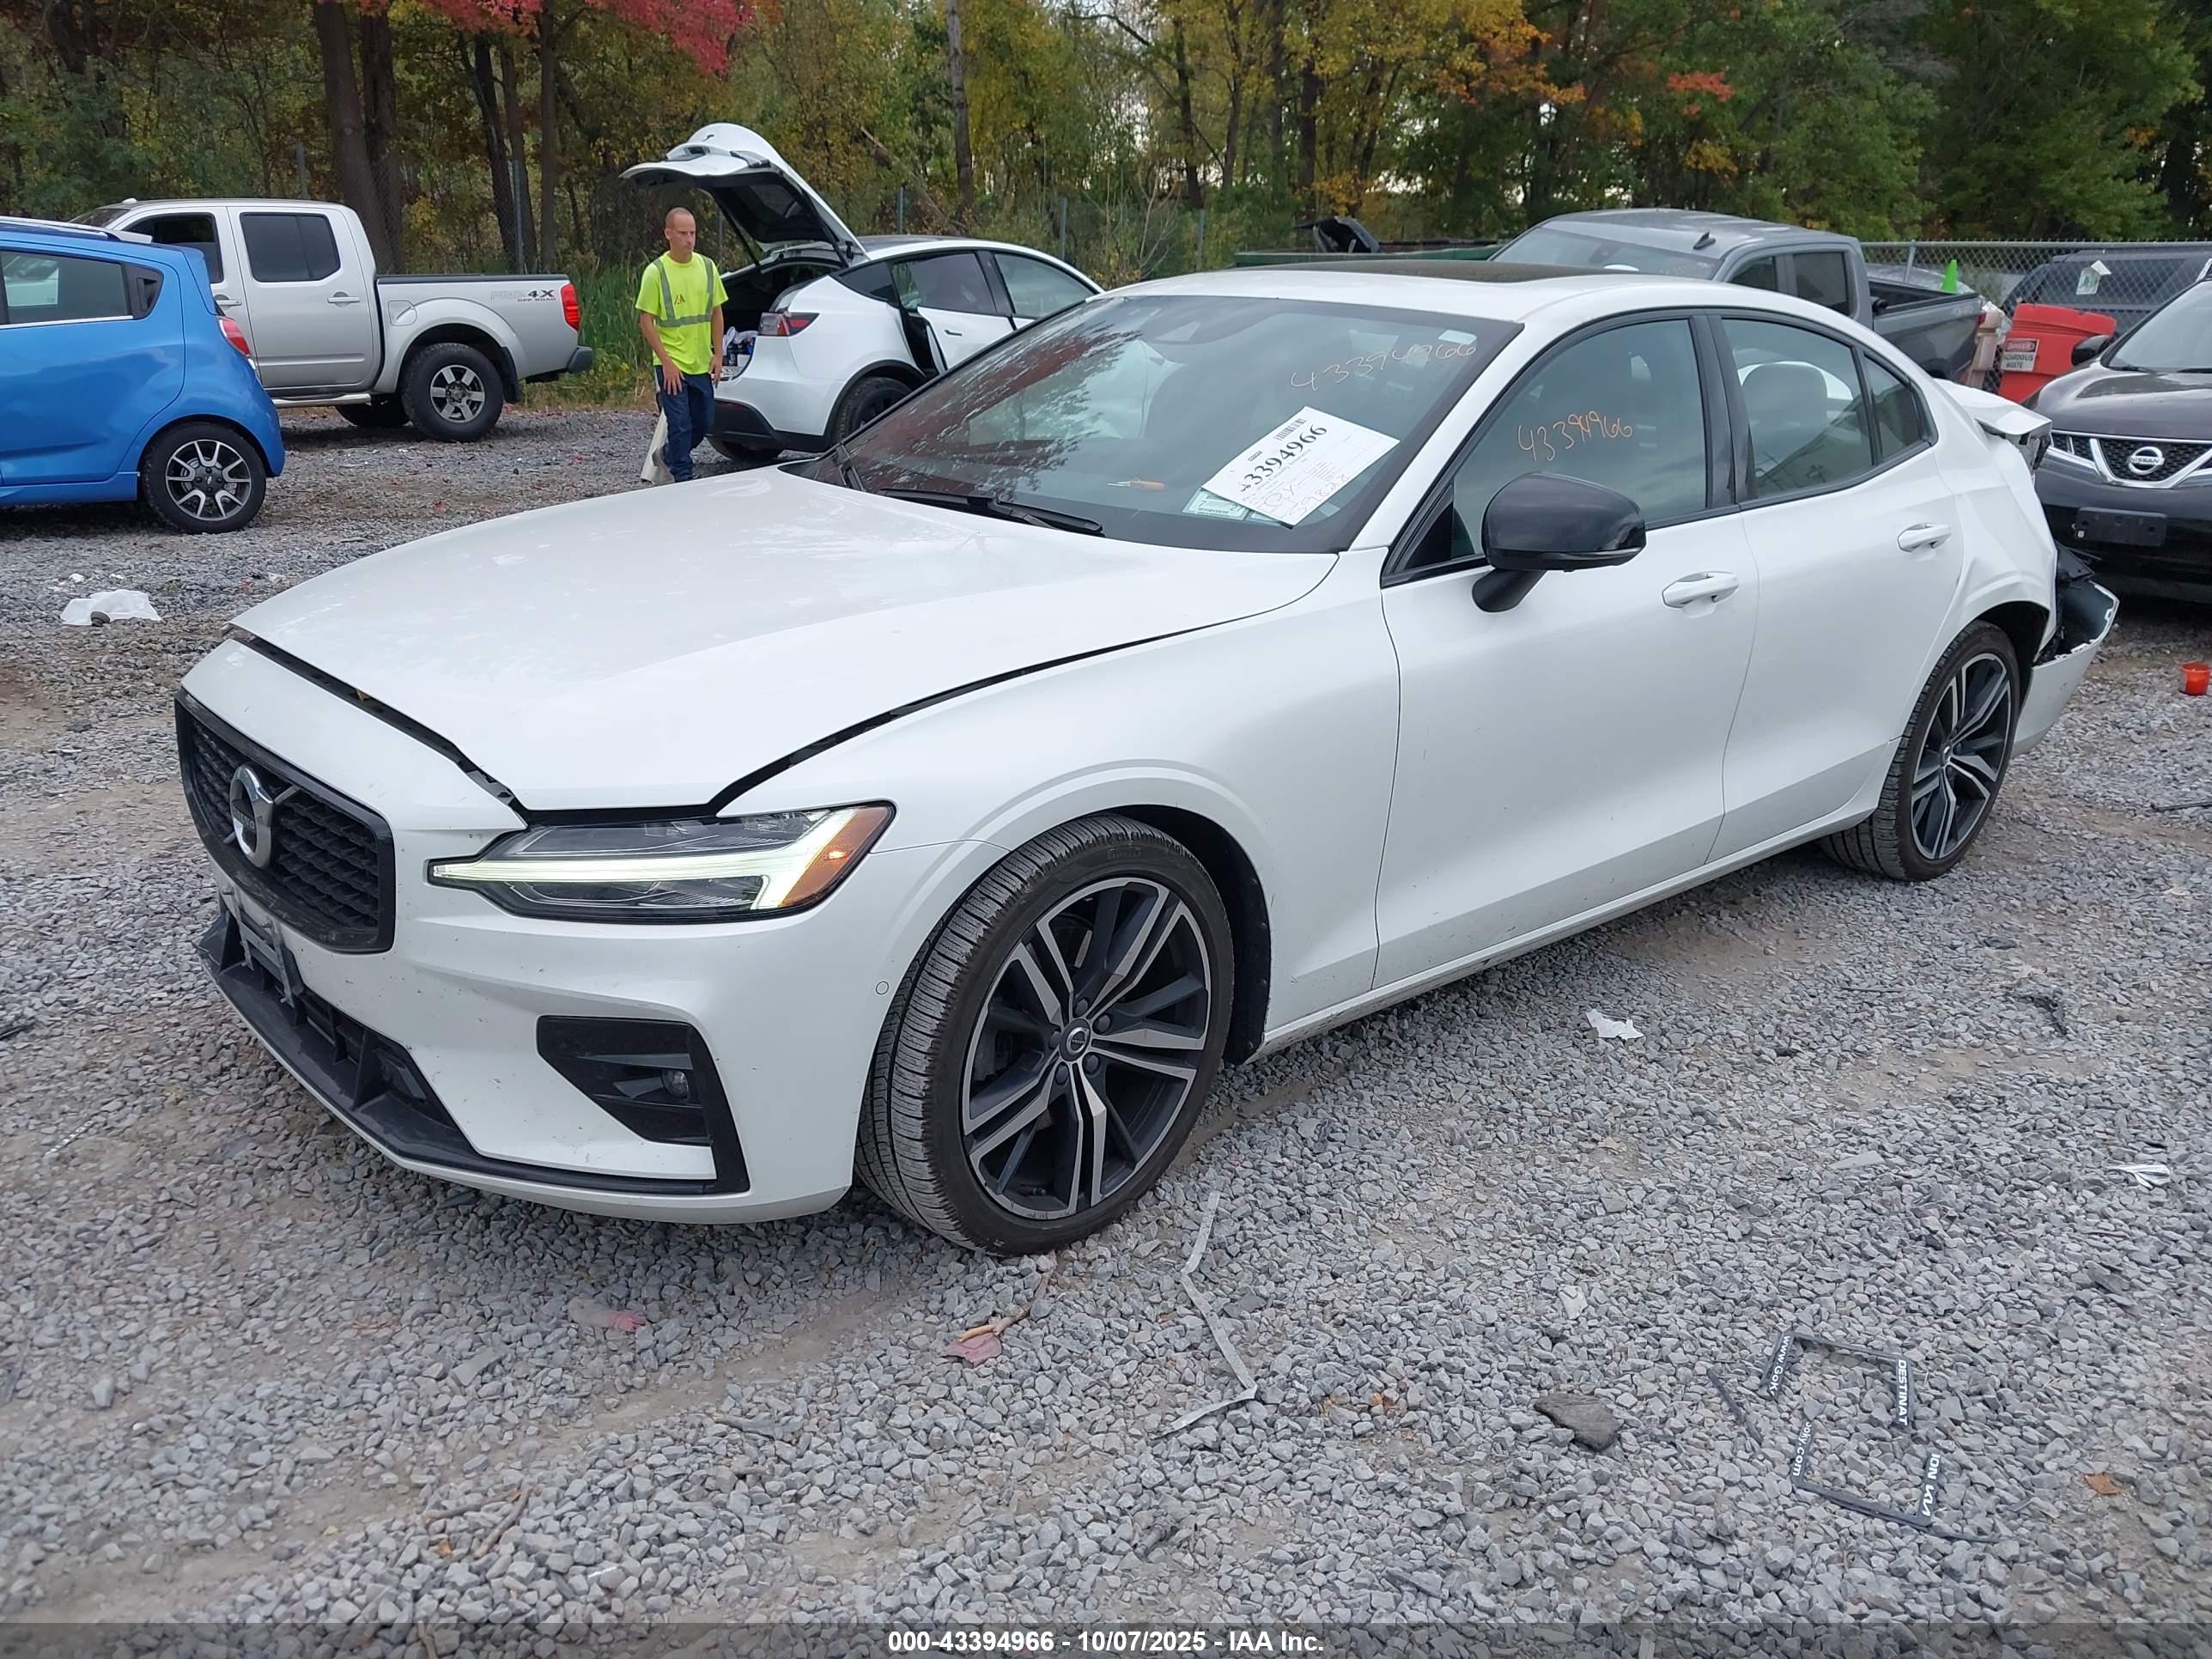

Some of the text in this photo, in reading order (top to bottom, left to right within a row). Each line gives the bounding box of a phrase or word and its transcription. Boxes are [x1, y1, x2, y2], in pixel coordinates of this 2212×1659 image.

[1291, 343, 1477, 392] 43394966
[1239, 424, 1328, 493] 43394966
[1517, 410, 1633, 461] 43394966
